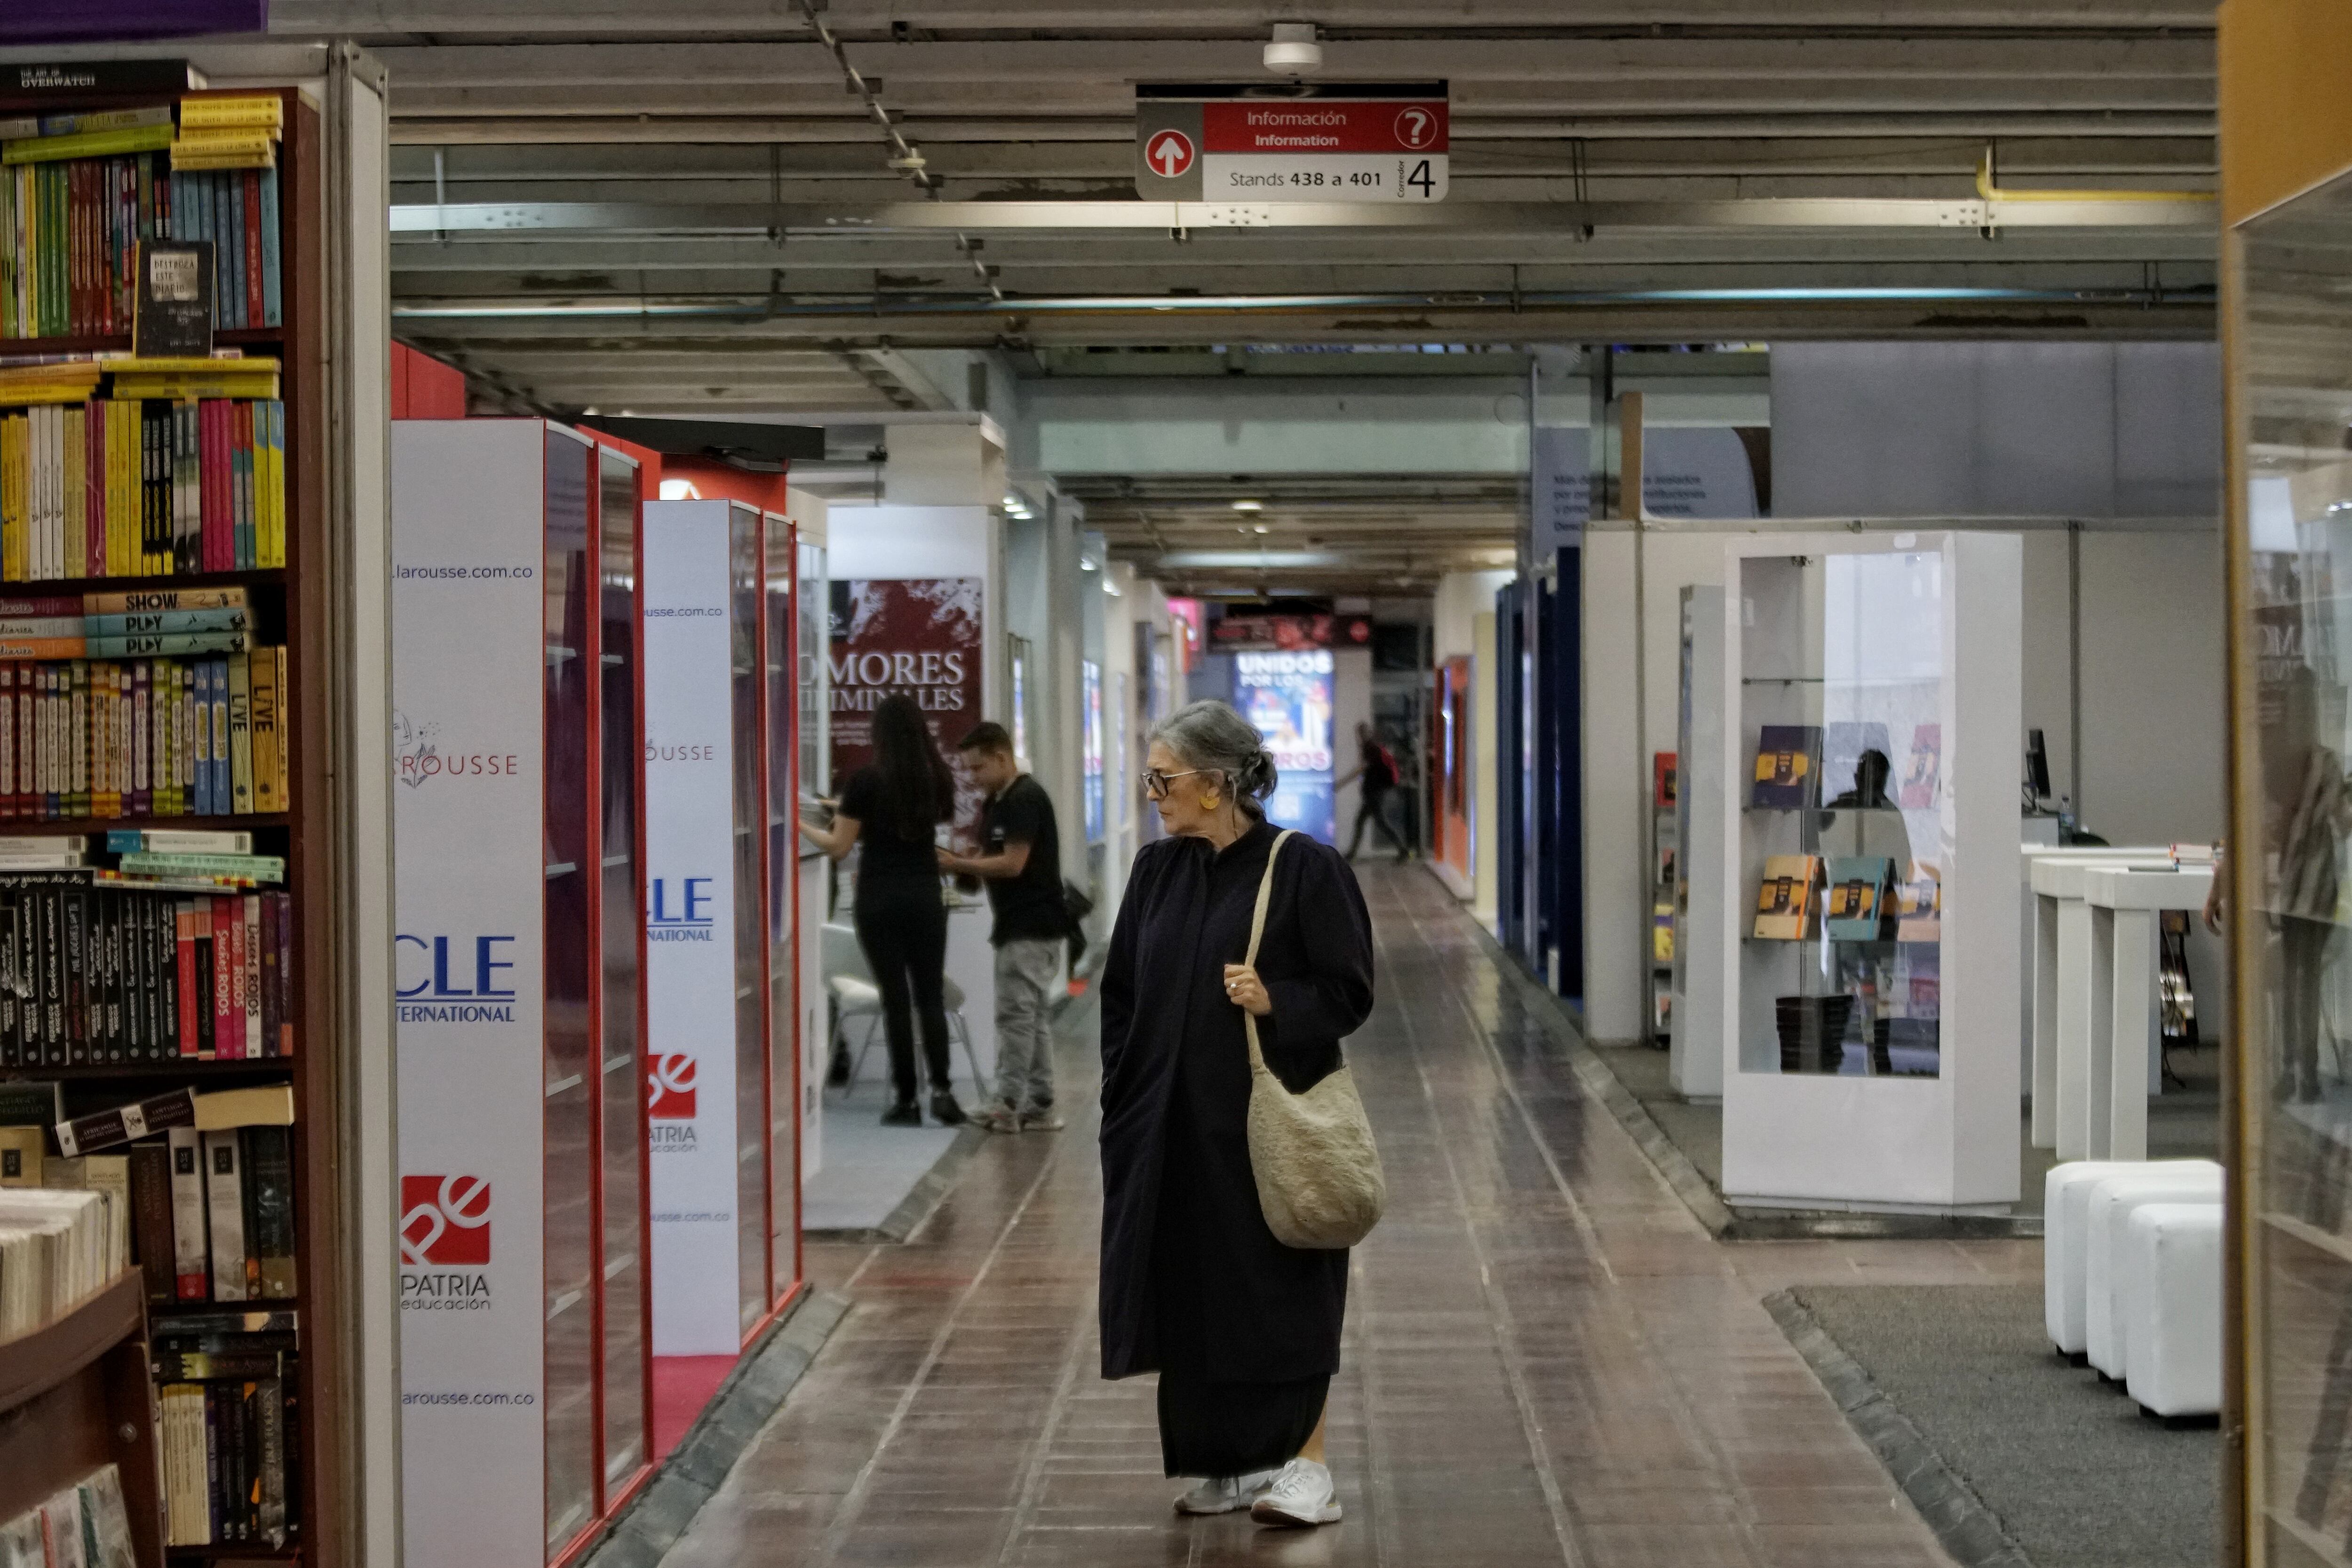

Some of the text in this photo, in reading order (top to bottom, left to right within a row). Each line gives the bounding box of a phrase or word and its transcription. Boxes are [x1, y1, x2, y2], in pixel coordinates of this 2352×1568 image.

[1247, 111, 1347, 126] Información
[1255, 134, 1339, 146] Information
[1230, 172, 1382, 187] Stands 438 a 401
[1397, 160, 1406, 198] Corredor
[1407, 160, 1436, 198] 4
[126, 594, 178, 611] SHOW
[644, 608, 722, 617] usse.com.co
[1237, 651, 1335, 674] UNIDOS
[393, 755, 517, 775] ROUSSE
[216, 974, 230, 1017] ROJOS
[233, 966, 244, 1009] ROJOS
[245, 974, 260, 1018] ROJOS
[400, 1274, 490, 1297] PATRIA
[400, 1298, 490, 1310] educación
[402, 1391, 534, 1405] arousse.com.co
